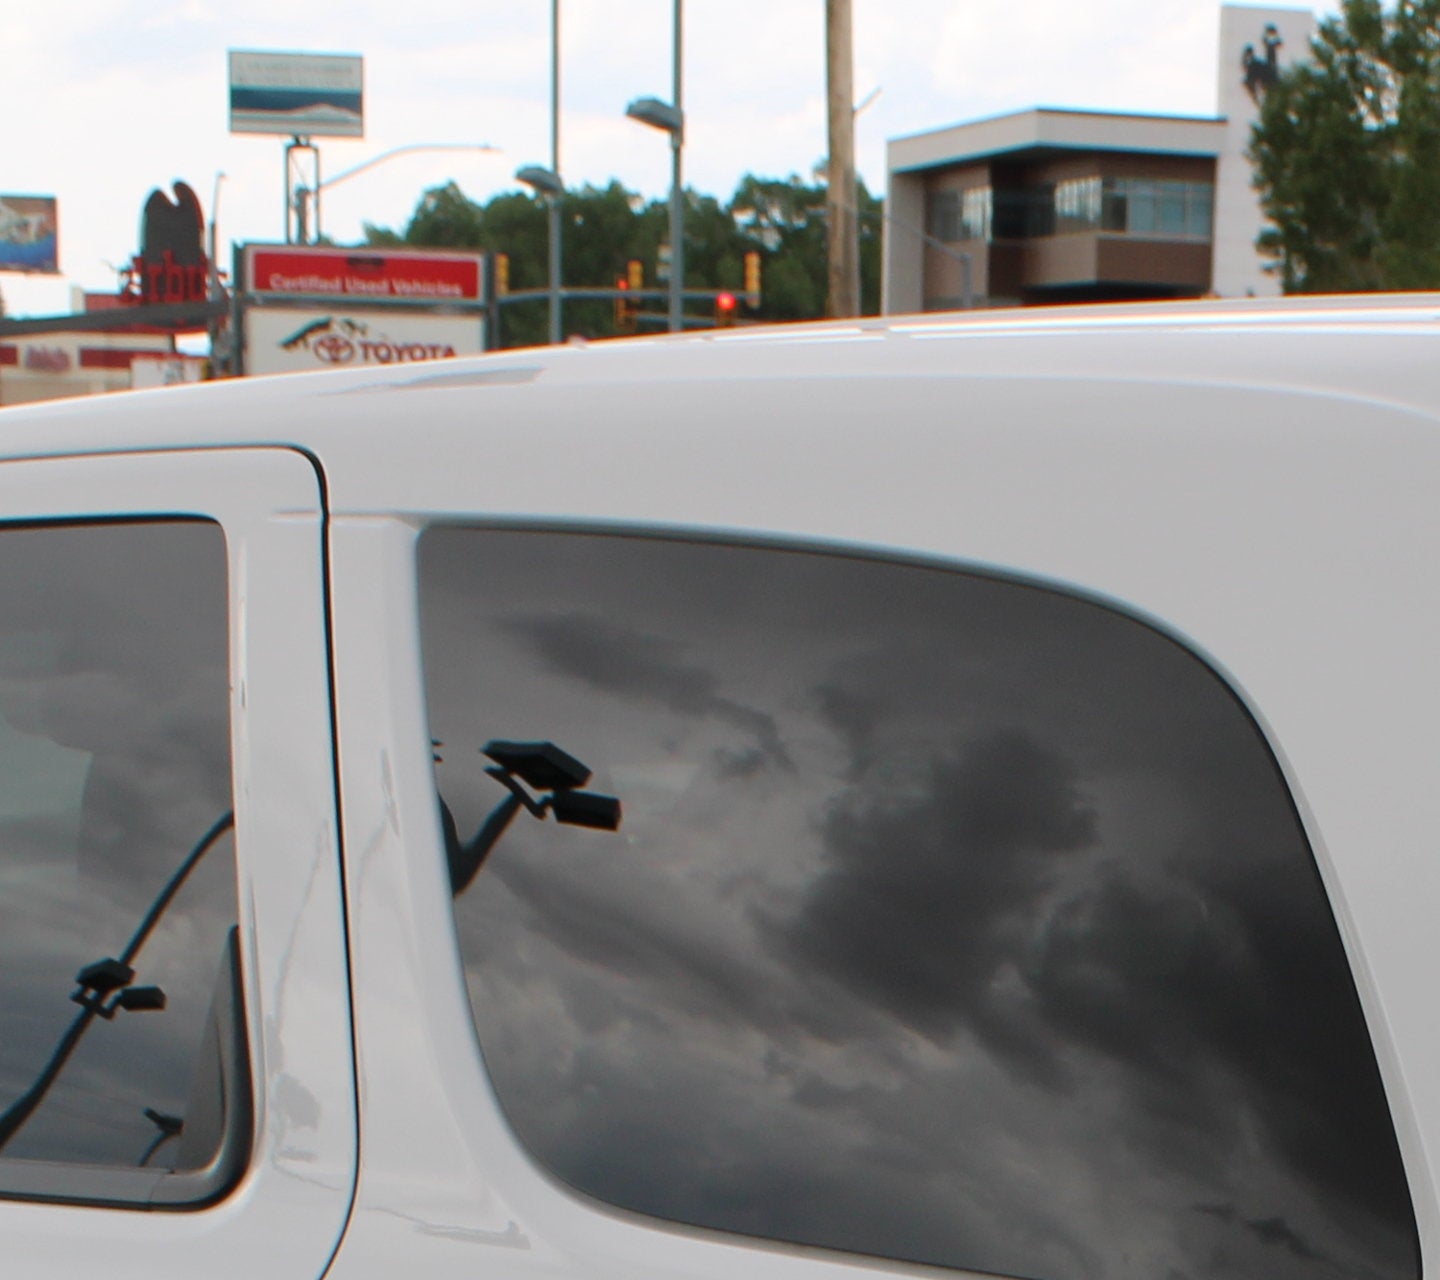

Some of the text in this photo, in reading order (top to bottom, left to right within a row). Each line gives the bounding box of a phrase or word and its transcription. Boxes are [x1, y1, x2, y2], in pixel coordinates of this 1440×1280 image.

[269, 273, 463, 298] Certified Used Vehicles
[359, 340, 457, 364] TOYOTA
